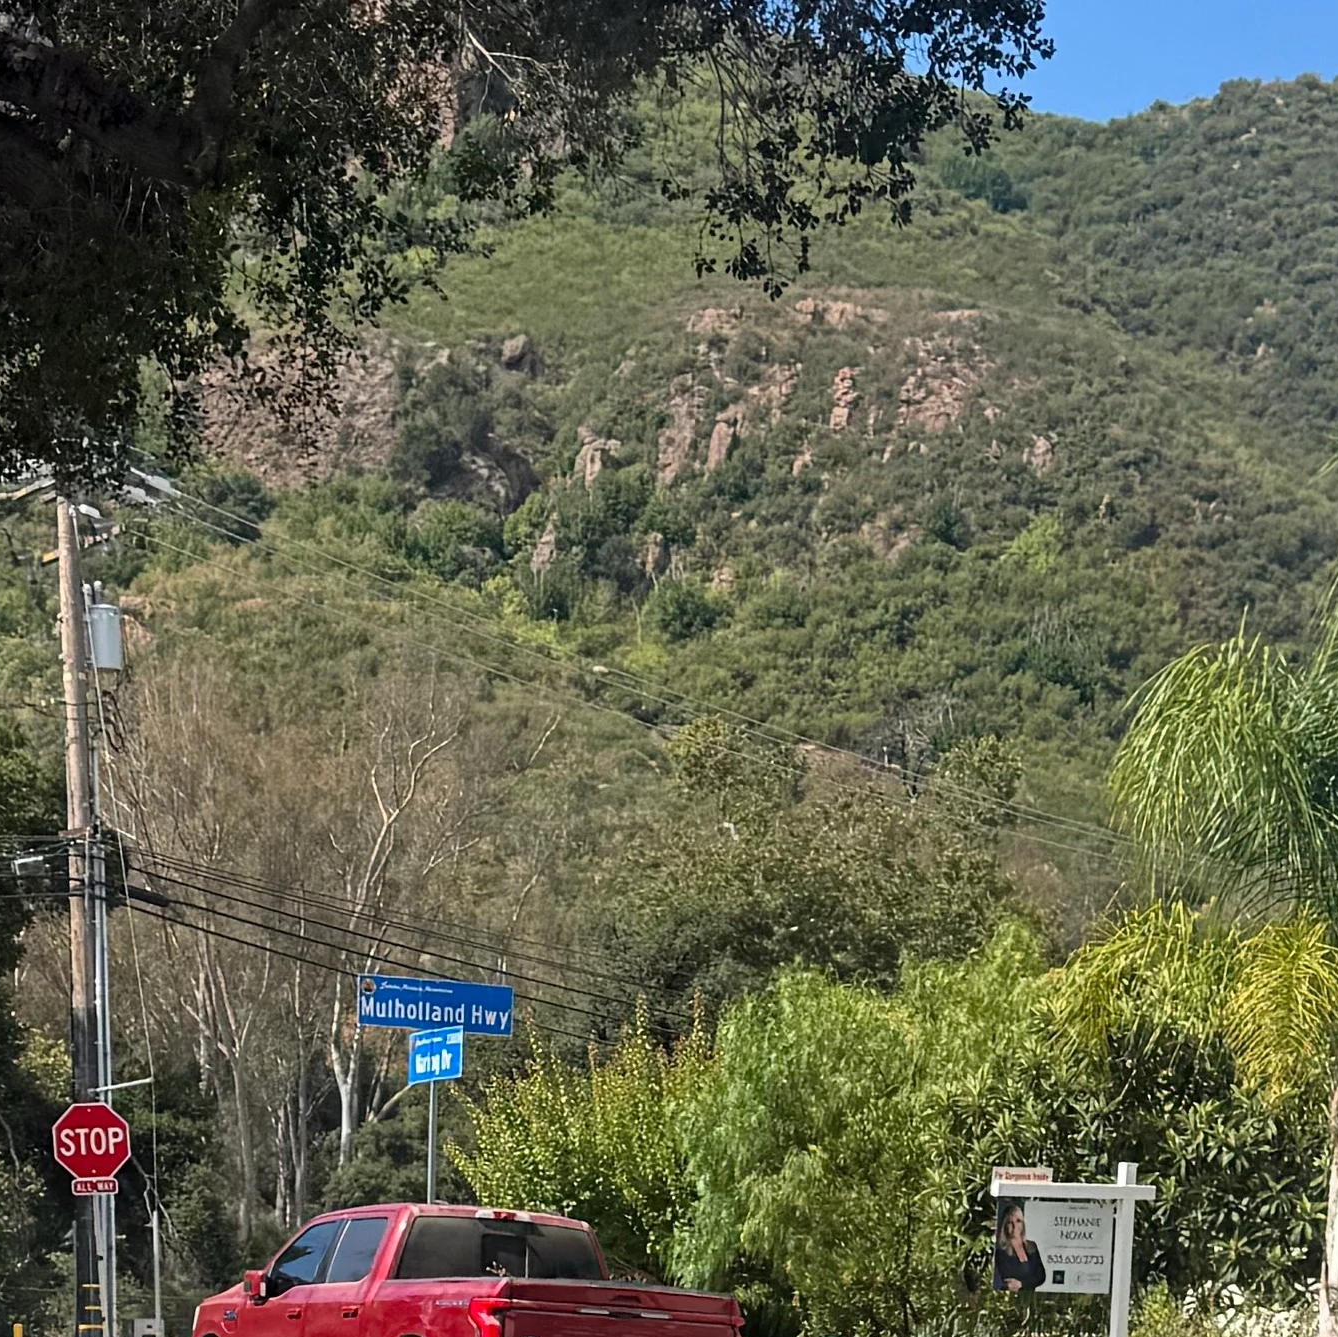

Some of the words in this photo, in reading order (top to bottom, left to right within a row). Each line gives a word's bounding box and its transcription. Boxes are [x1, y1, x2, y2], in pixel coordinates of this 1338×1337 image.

[361, 996, 464, 1023] Mulholland
[470, 1004, 510, 1030] Hwy
[60, 1127, 123, 1156] STOP
[76, 1182, 93, 1192] ALL
[96, 1182, 113, 1191] WAY
[1053, 1216, 1101, 1227] STEPHANIE
